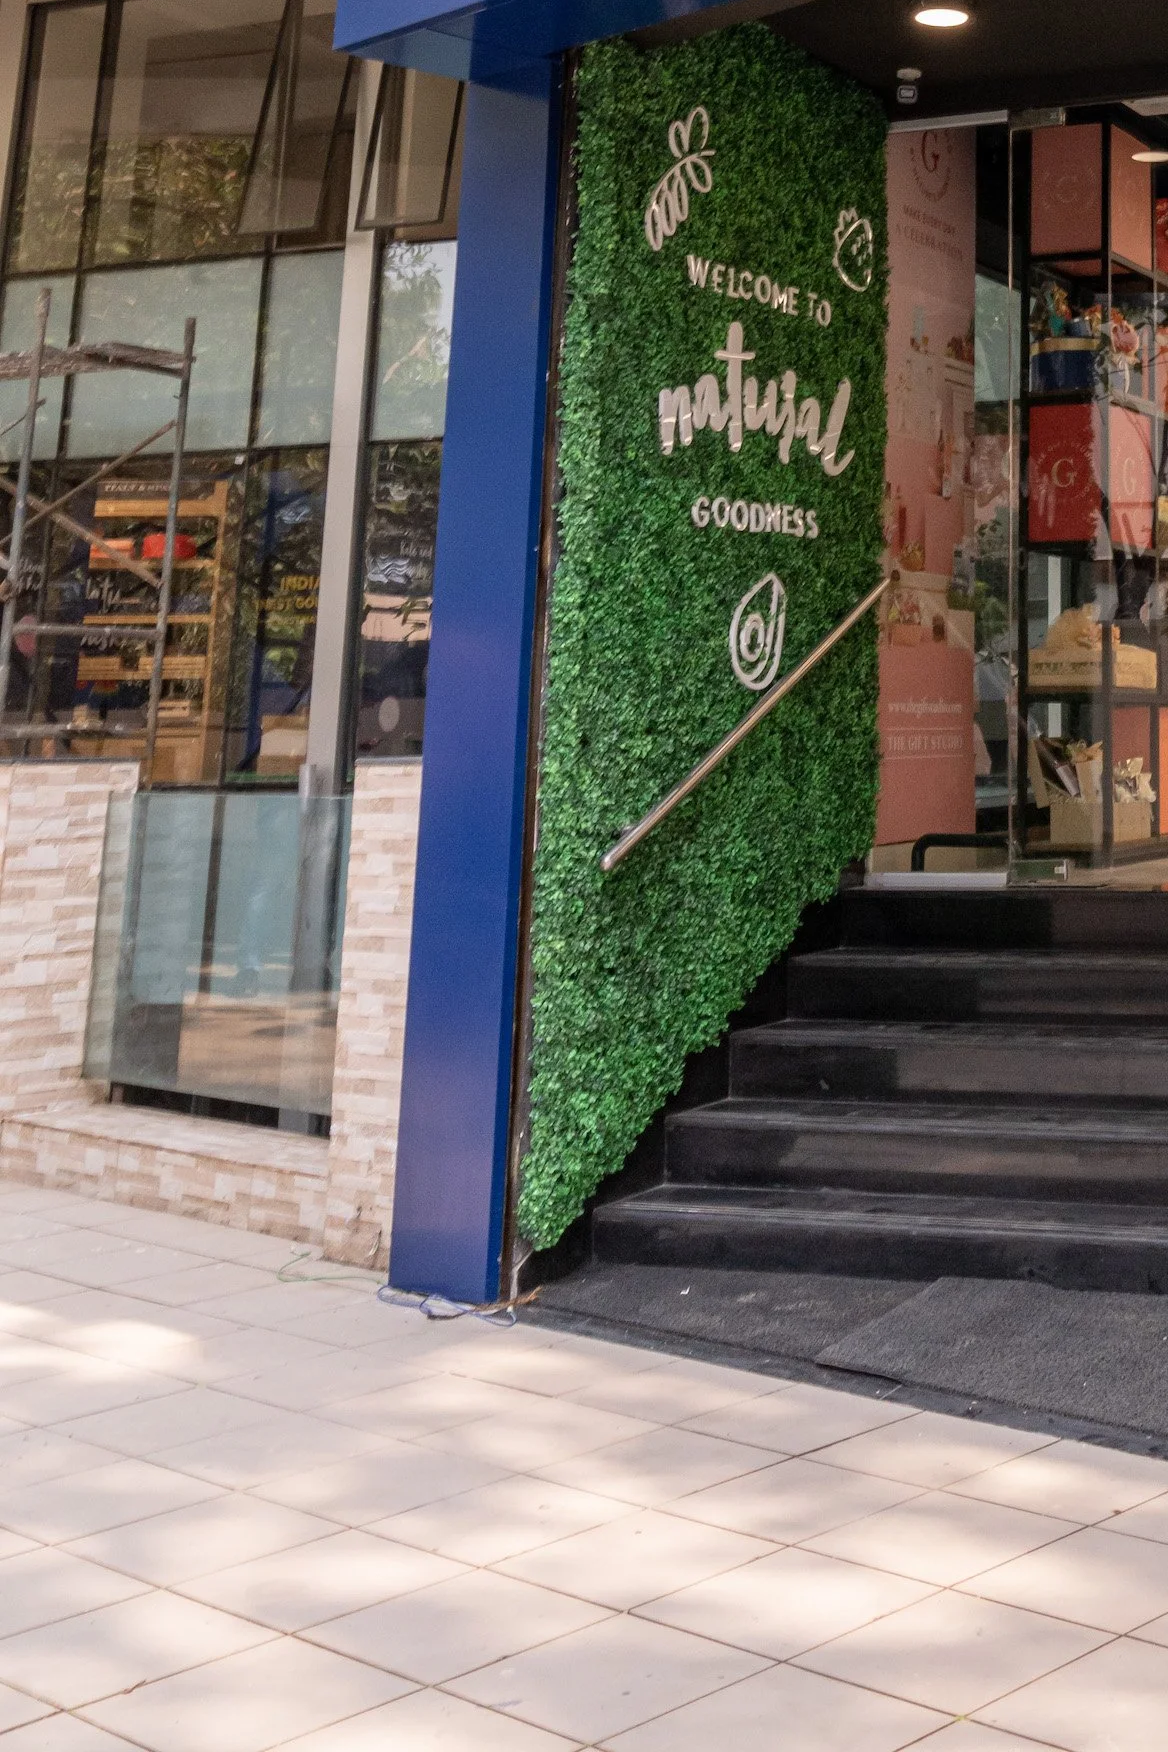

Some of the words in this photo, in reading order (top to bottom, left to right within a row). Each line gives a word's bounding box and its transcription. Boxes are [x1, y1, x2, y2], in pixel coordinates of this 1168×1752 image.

[686, 252, 800, 316] WELCOME
[806, 291, 832, 327] TO
[657, 320, 855, 477] natural
[1051, 457, 1078, 488] G
[690, 495, 819, 539] GOODNESS
